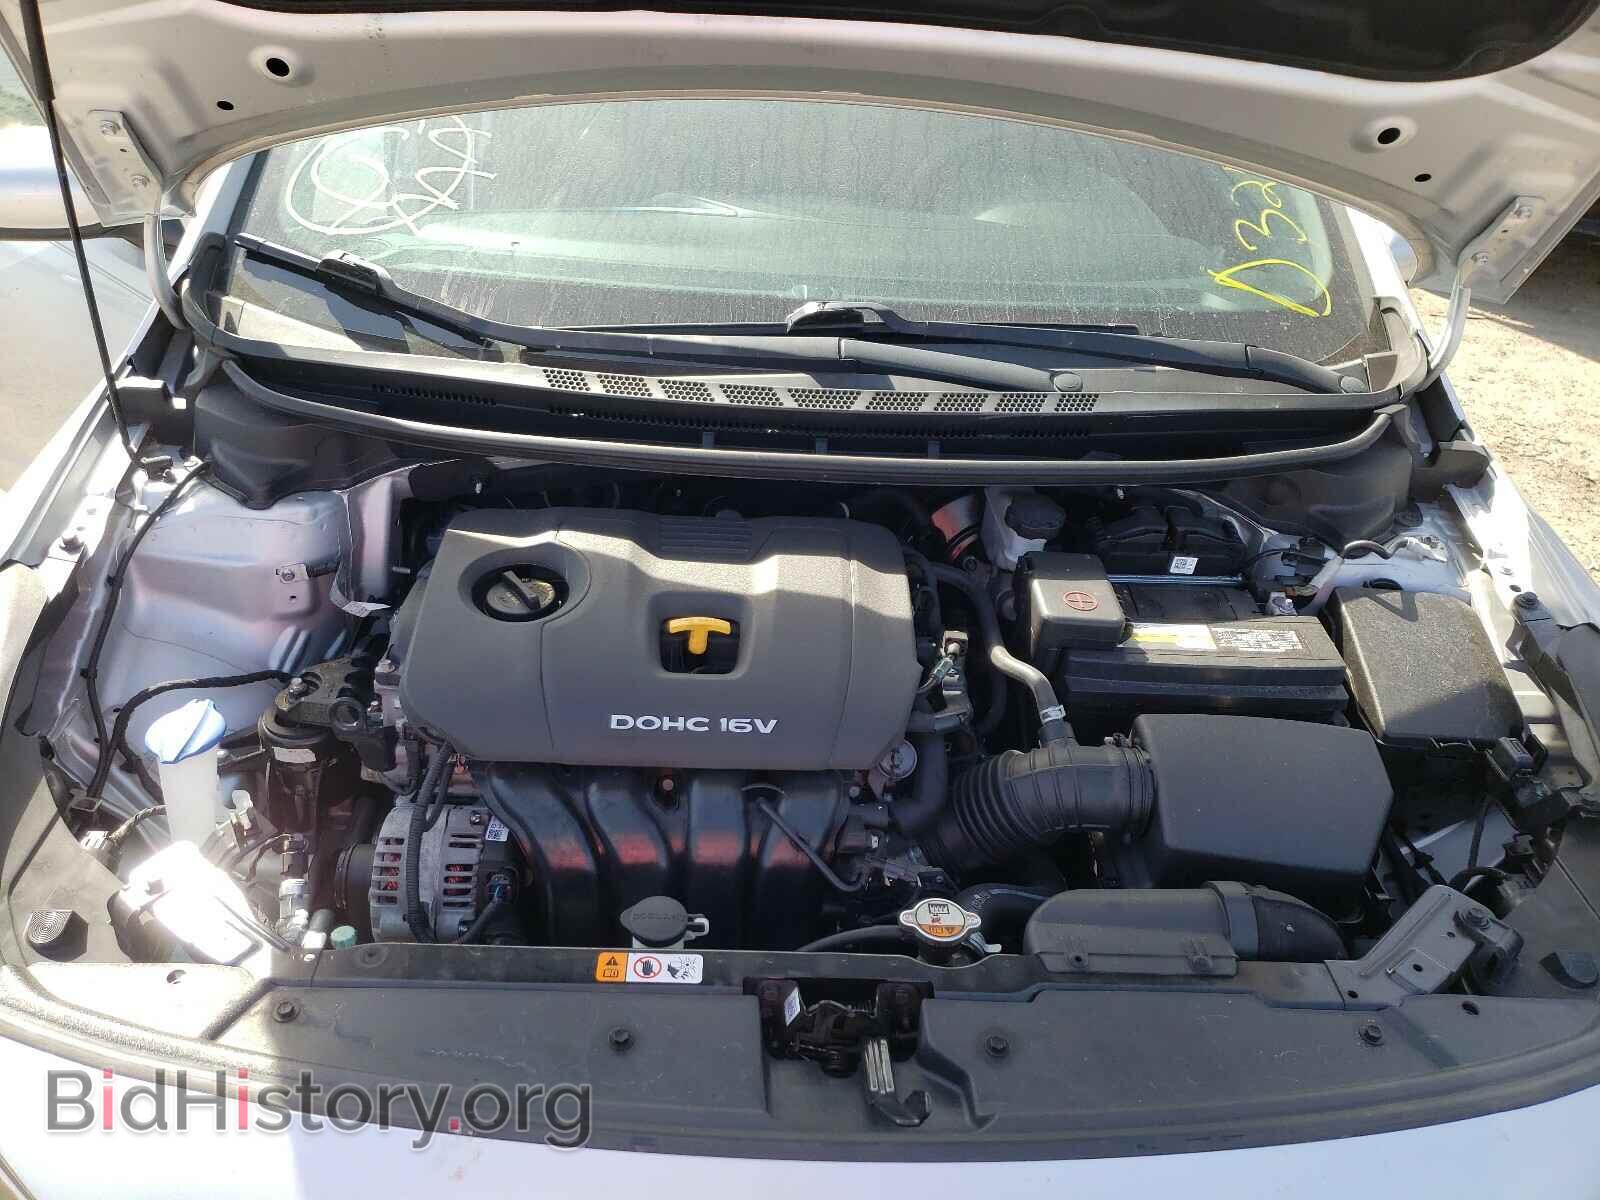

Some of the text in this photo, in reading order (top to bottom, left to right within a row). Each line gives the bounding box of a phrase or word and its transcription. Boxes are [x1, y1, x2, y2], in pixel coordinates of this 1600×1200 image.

[1207, 167, 1332, 317] D32
[610, 714, 778, 734] DOHC 16V
